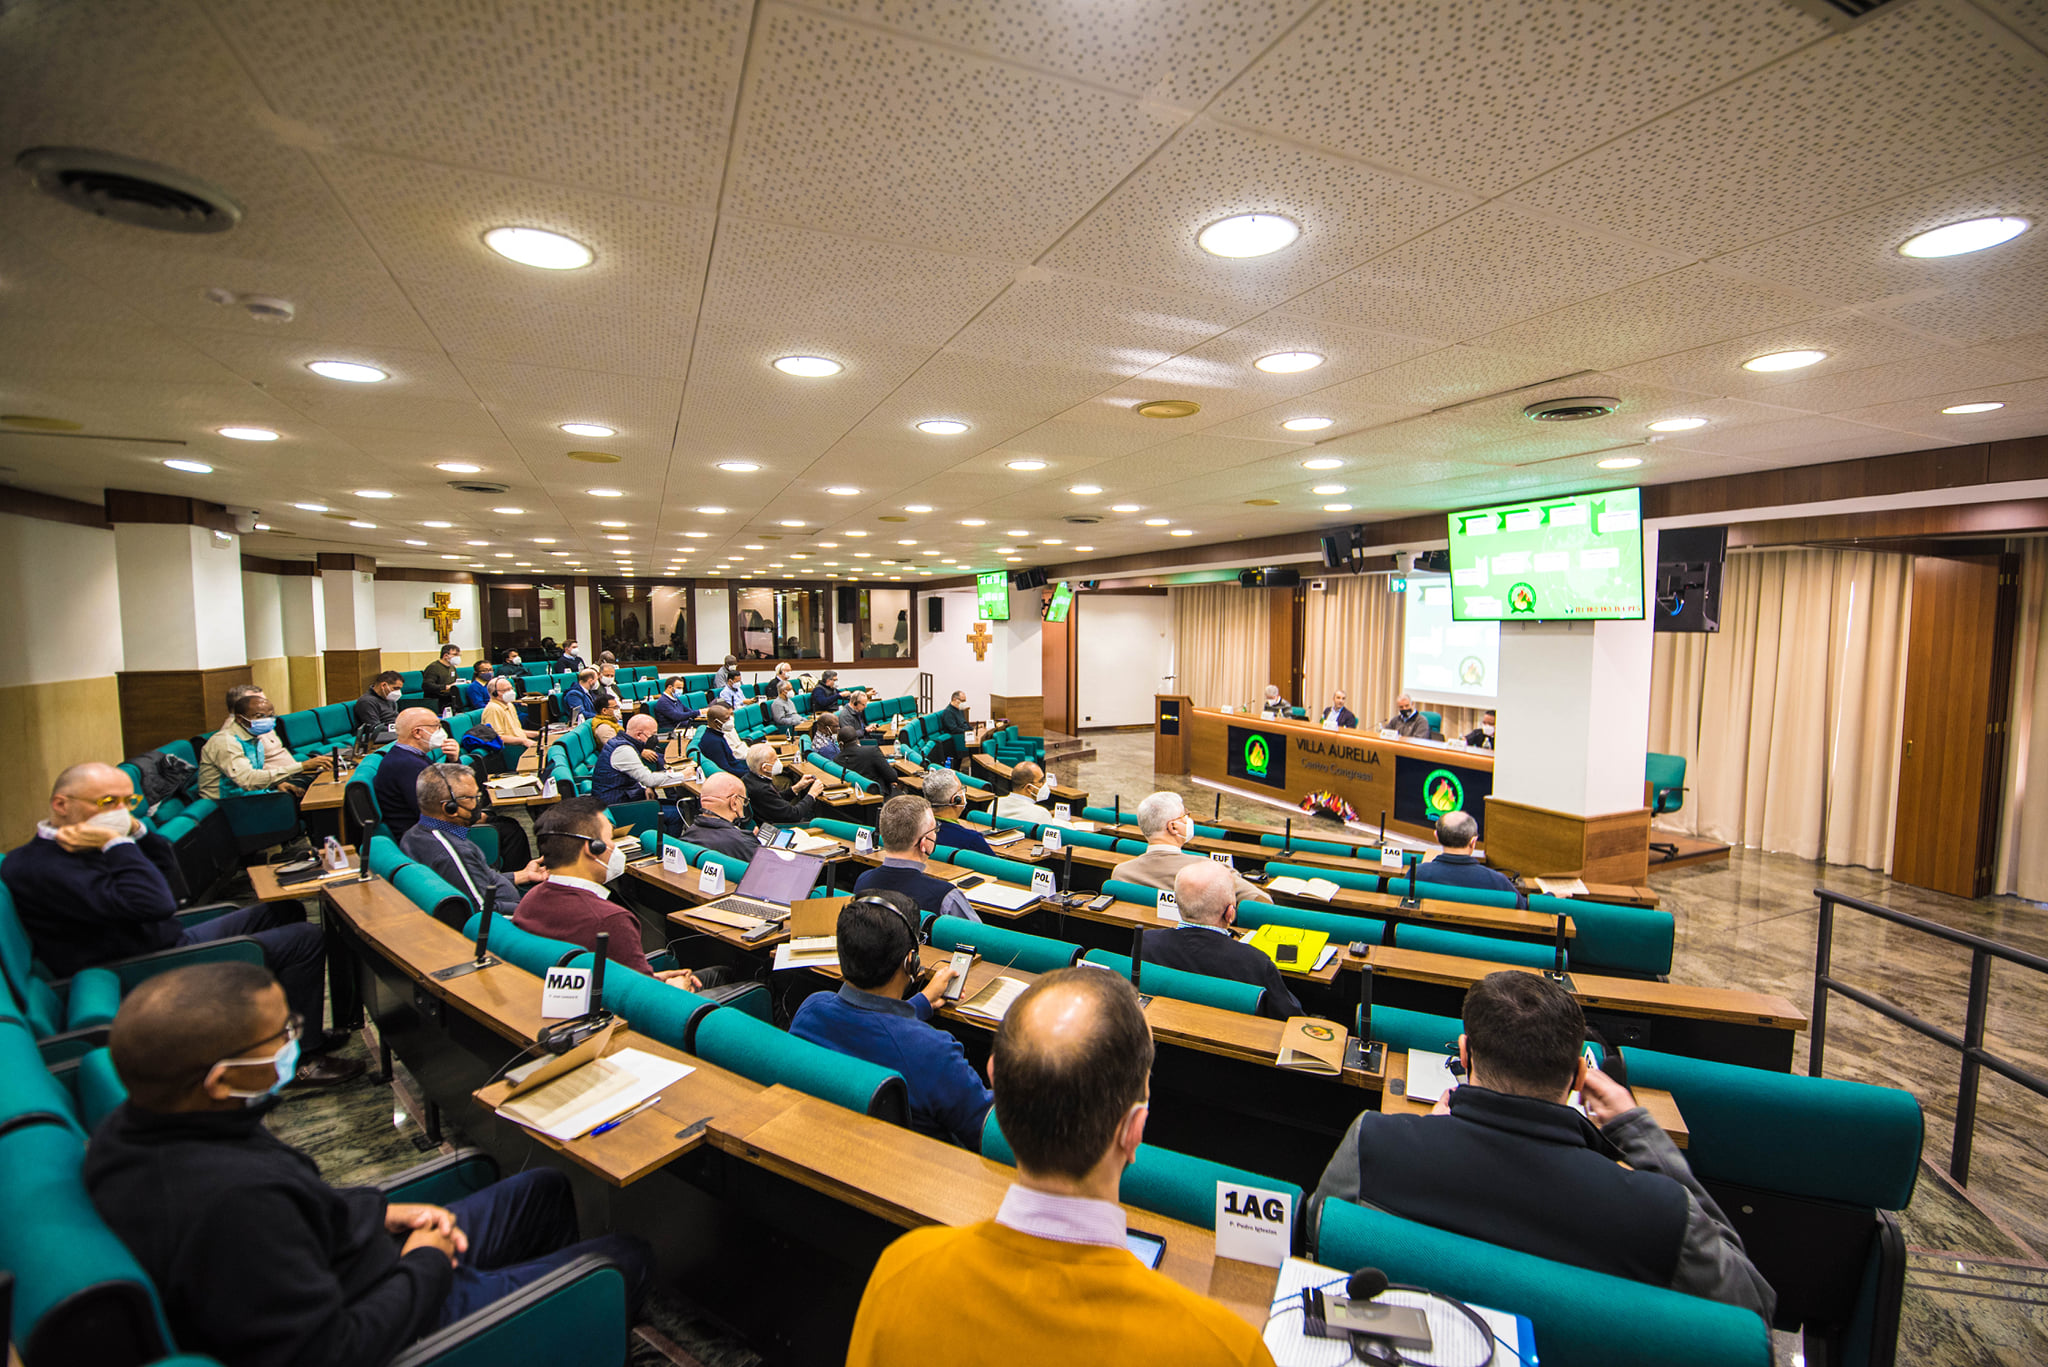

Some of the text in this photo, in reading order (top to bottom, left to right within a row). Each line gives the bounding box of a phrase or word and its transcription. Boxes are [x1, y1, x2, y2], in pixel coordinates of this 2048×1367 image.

[1296, 737, 1381, 766] VILLA AURELIA
[1301, 757, 1329, 773] Centro
[1045, 830, 1058, 839] BRE
[665, 847, 677, 858] PHI
[1213, 854, 1230, 863] EUF
[703, 865, 718, 878] USA
[1034, 871, 1050, 884] POL
[1159, 892, 1177, 904] AC
[547, 974, 586, 990] MAD
[1224, 1190, 1285, 1224] 1AG
